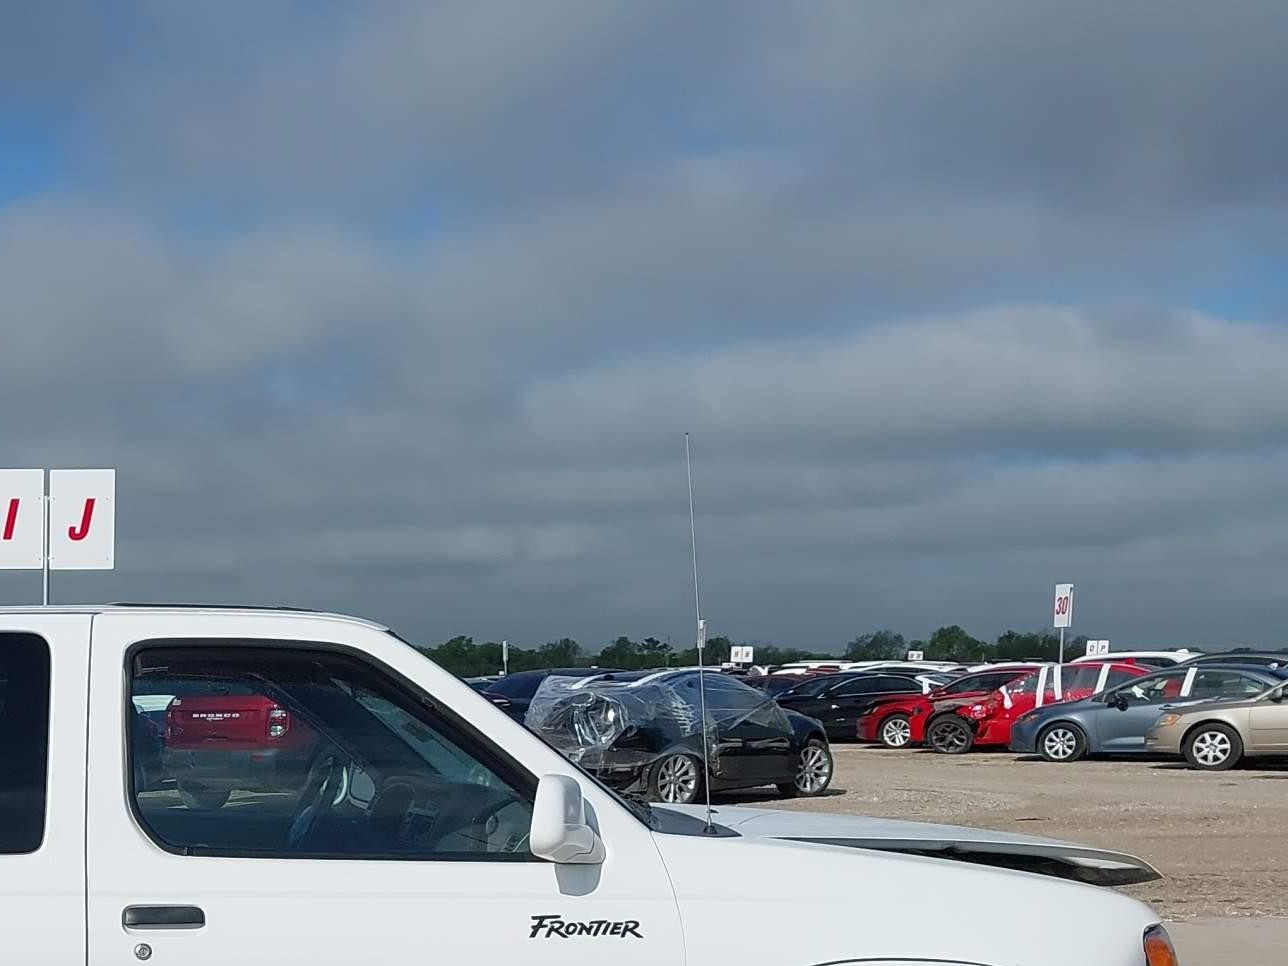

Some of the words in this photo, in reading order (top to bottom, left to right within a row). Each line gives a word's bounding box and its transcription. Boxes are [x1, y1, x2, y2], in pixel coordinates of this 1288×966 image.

[2, 498, 20, 541] I
[67, 497, 97, 542] J
[1056, 596, 1069, 616] 30
